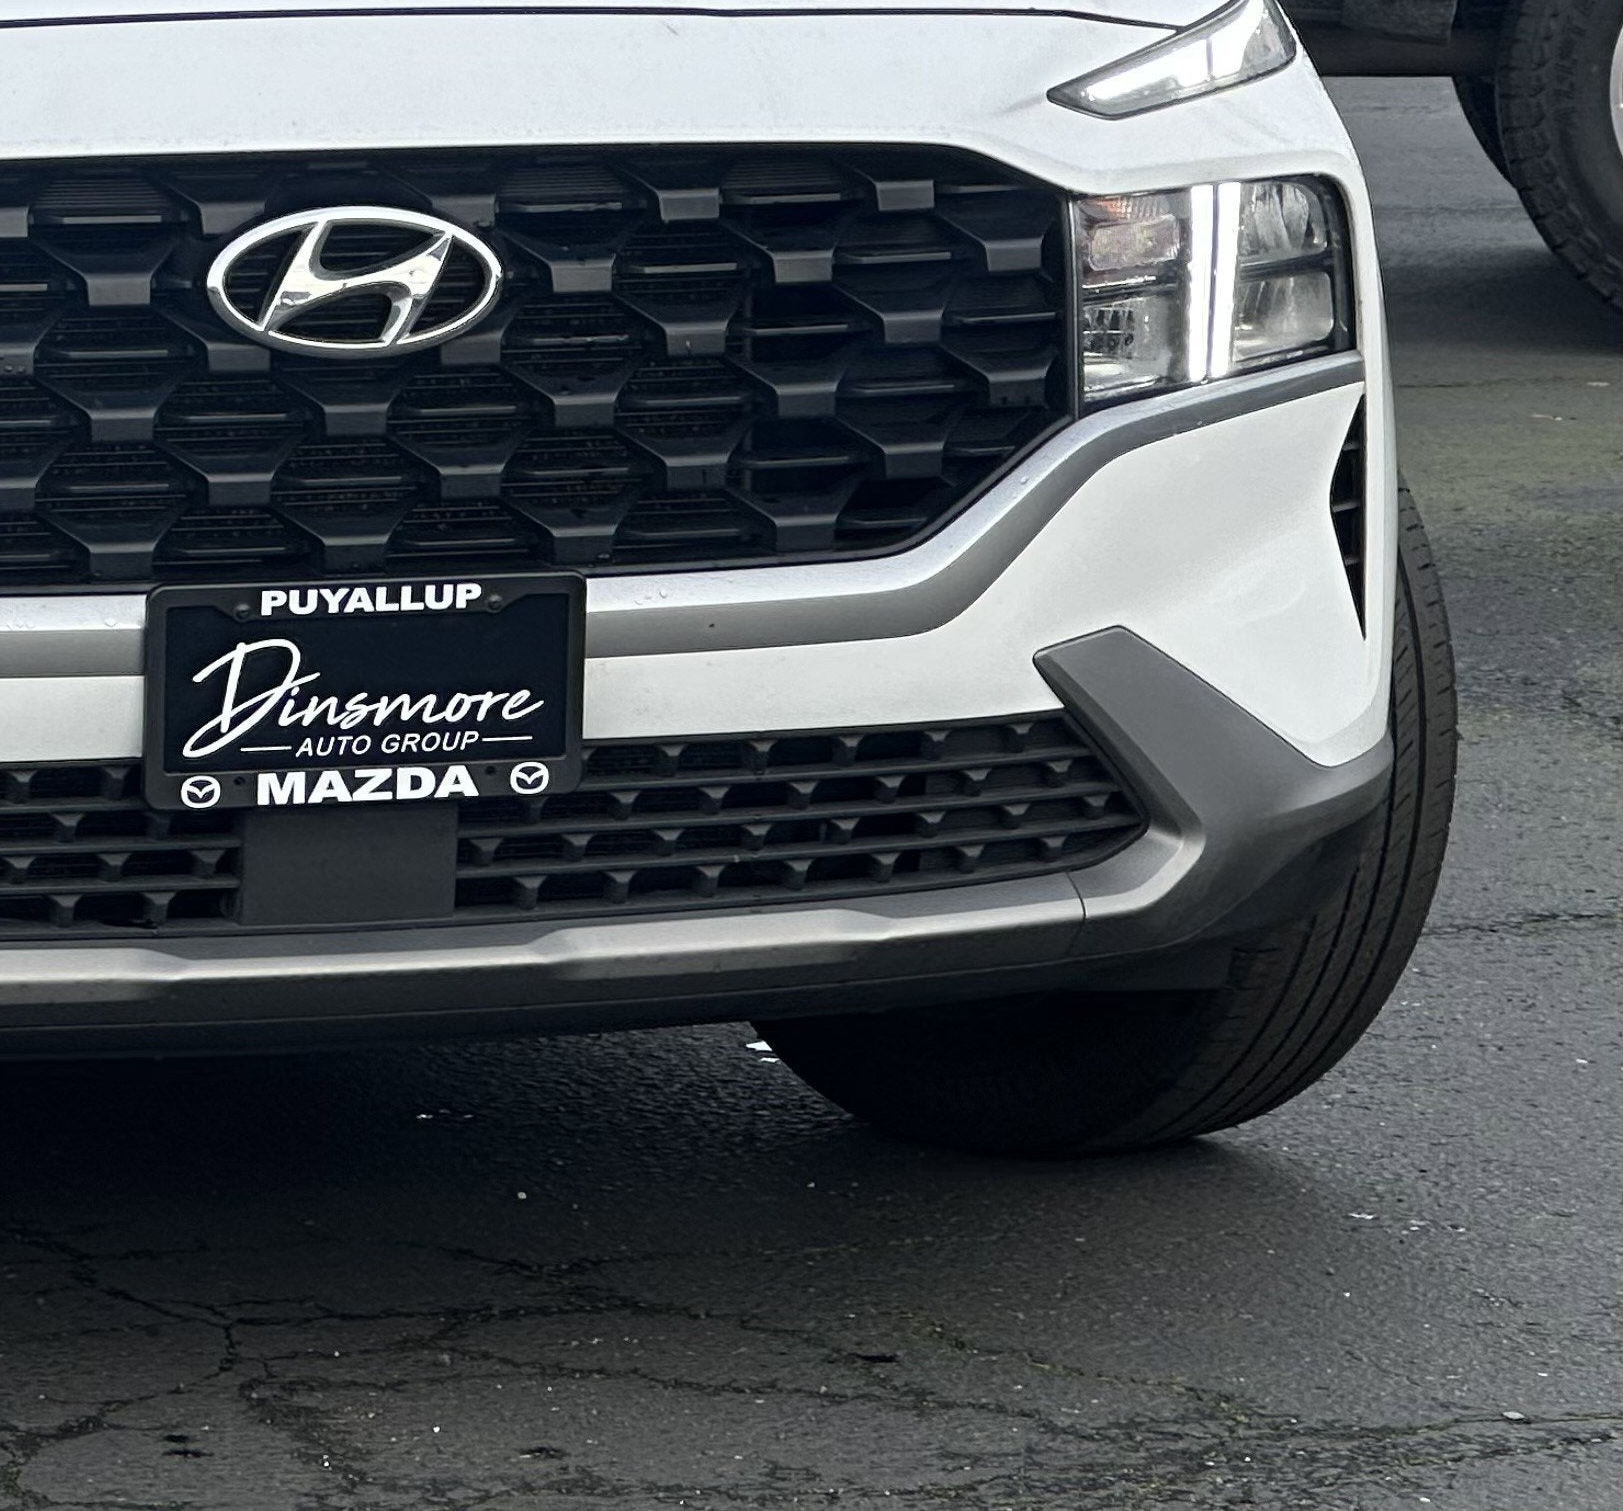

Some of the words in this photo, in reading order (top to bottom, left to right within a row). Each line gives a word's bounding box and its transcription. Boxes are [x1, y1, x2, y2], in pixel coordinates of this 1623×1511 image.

[260, 582, 482, 617] PUYALLUP
[182, 638, 544, 758] Dinsmore
[295, 735, 372, 758] AUTO
[380, 729, 480, 754] GROUP
[257, 764, 479, 807] MAZDA
